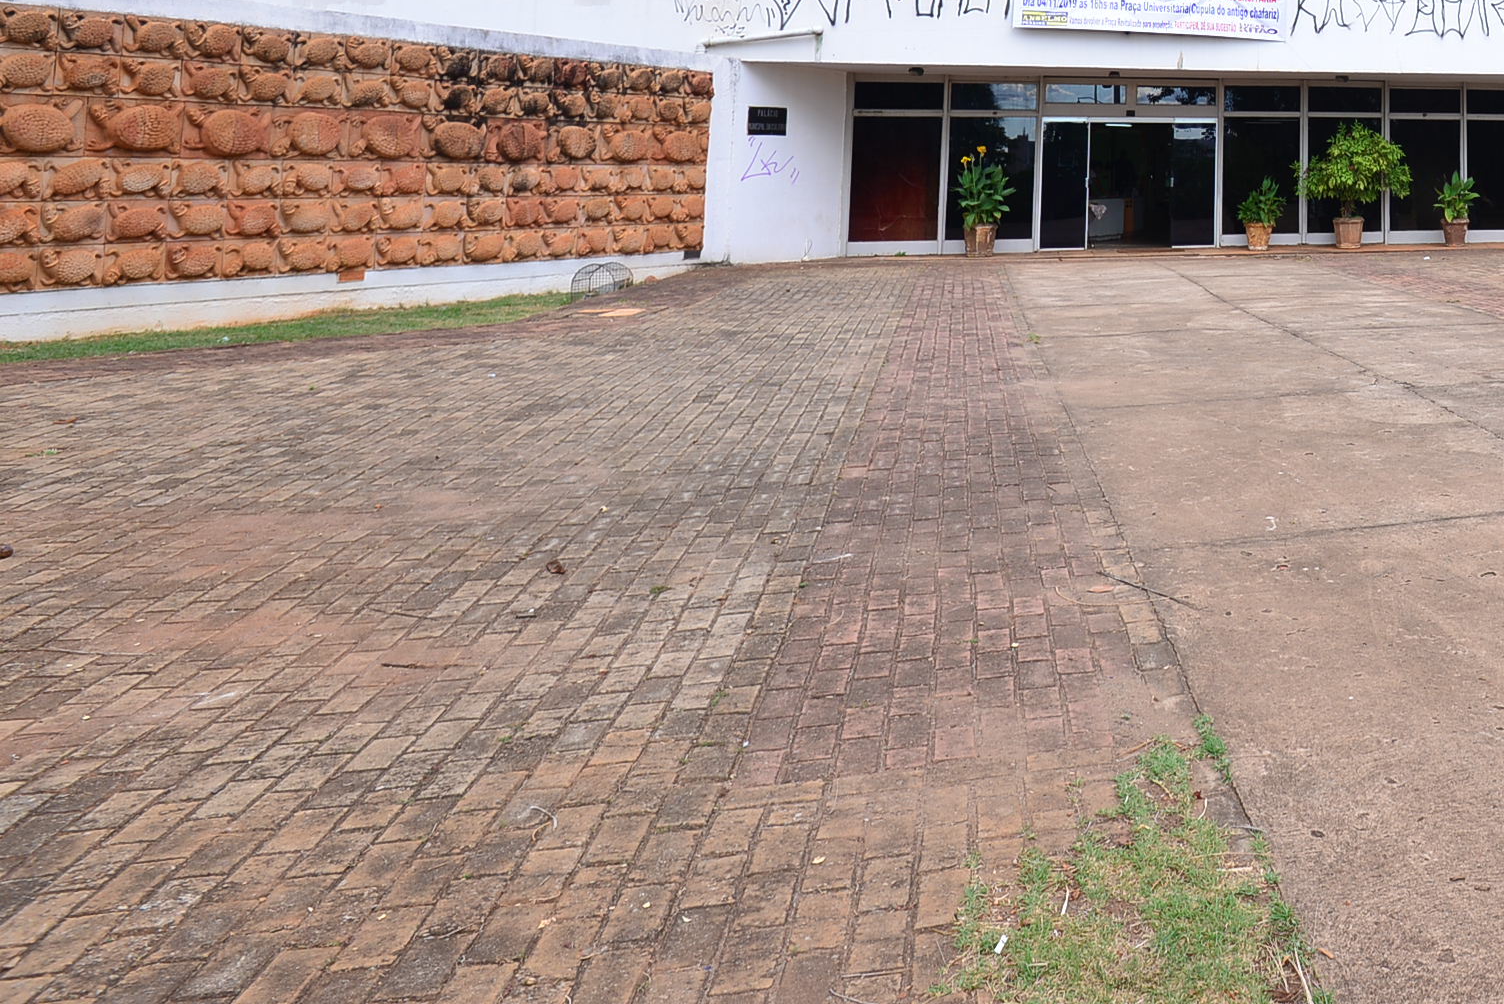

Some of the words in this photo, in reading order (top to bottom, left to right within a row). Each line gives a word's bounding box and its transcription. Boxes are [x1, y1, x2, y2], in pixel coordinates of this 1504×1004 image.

[1109, 0, 1119, 10] na
[1120, 0, 1142, 14] Praça
[1217, 4, 1226, 16] do
[1227, 5, 1248, 20] antigo
[1249, 6, 1280, 22] chafariz)
